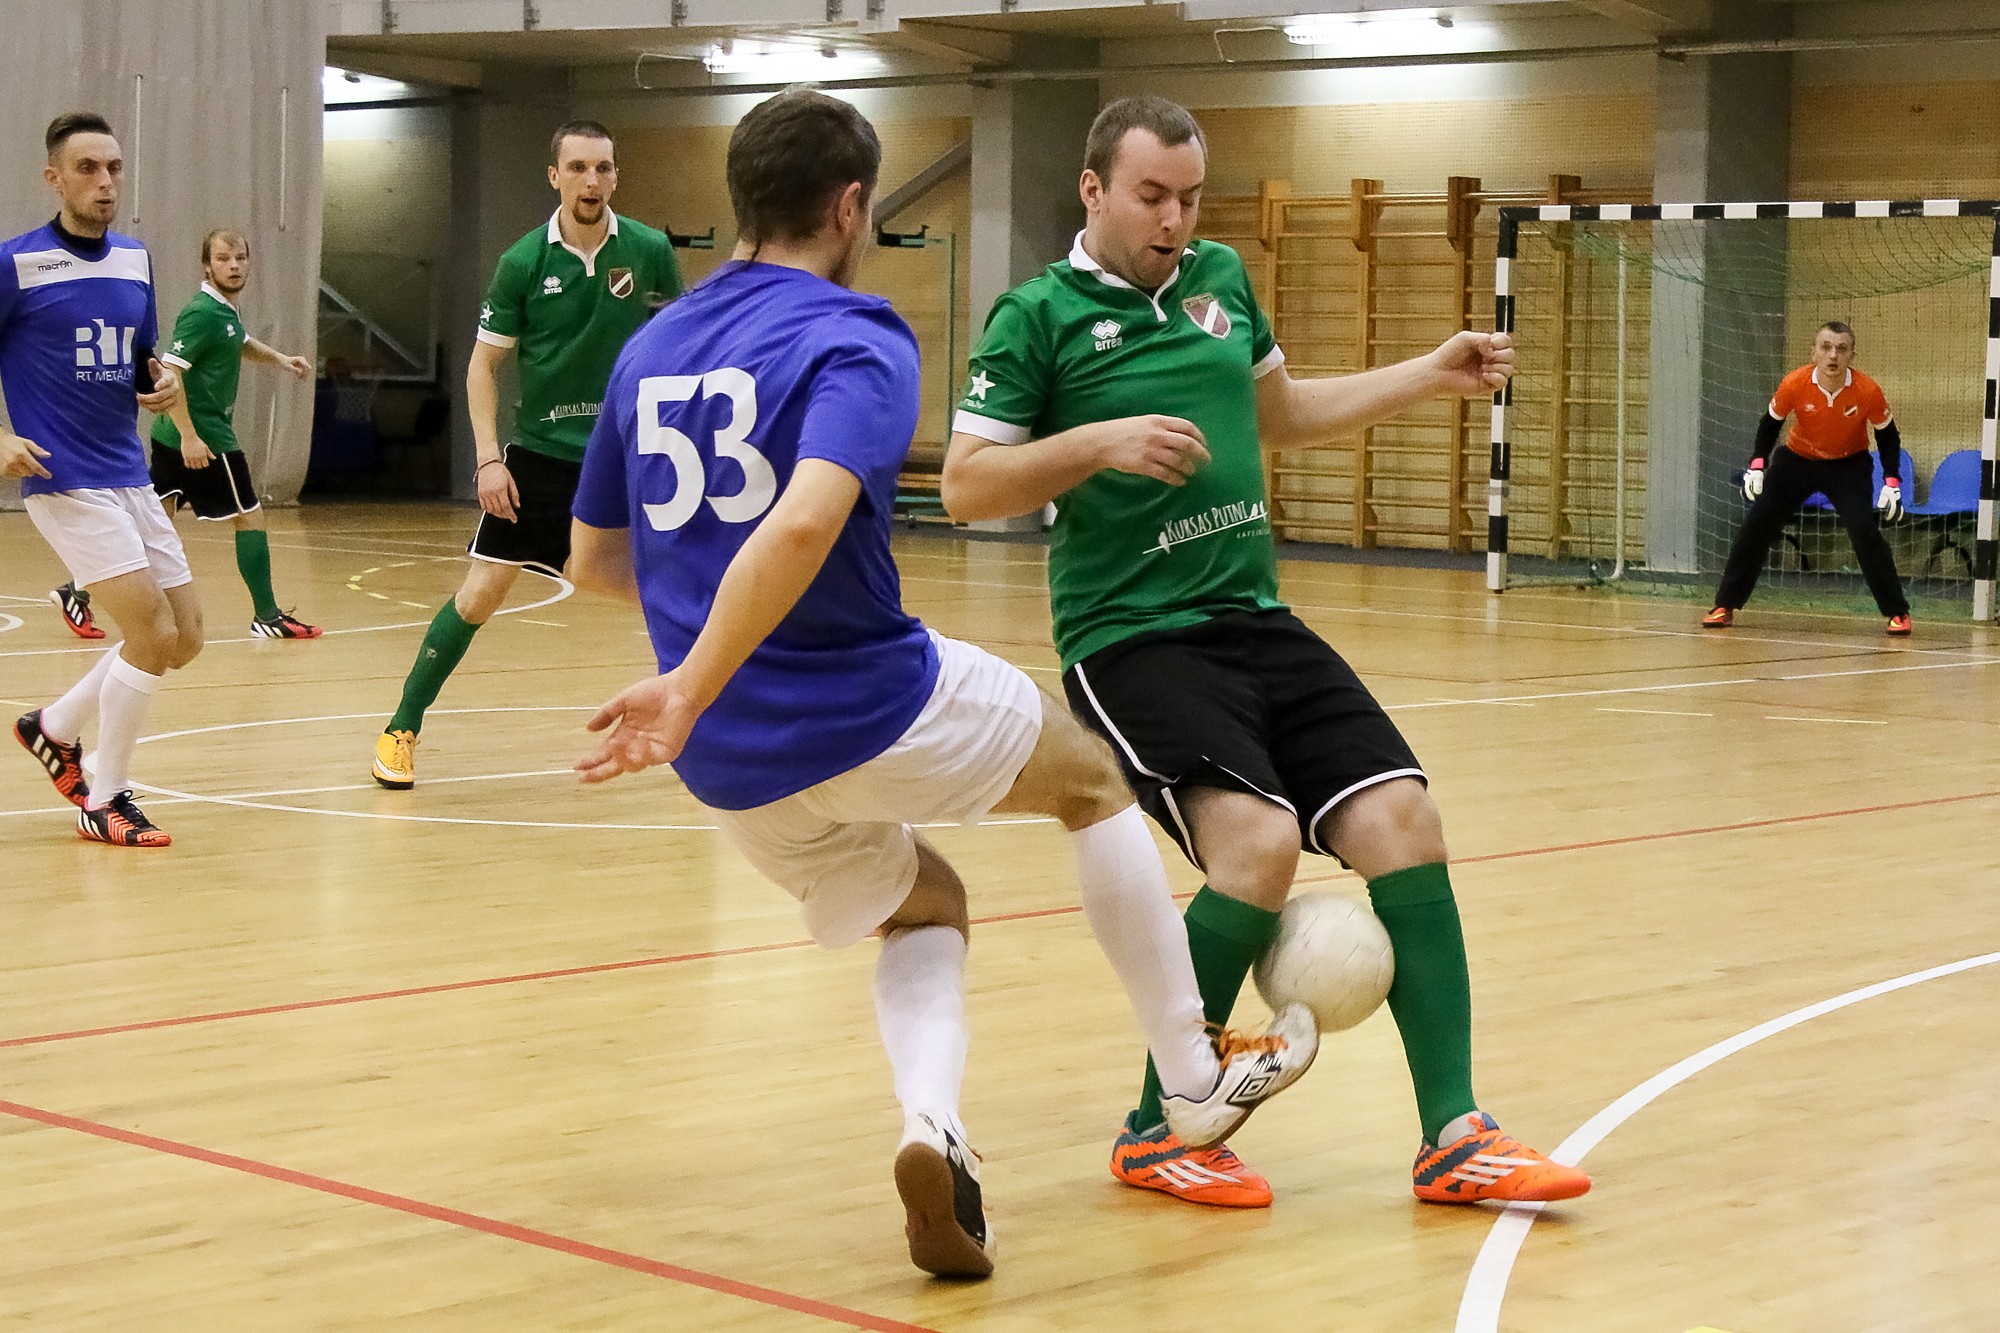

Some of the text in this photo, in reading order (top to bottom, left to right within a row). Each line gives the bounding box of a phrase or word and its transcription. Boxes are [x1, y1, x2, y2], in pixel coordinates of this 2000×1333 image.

[38, 260, 73, 271] macron
[1095, 337, 1122, 351] errea
[76, 371, 92, 381] RT
[637, 367, 777, 531] 53
[1165, 501, 1248, 542] KURSAS PUTNI
